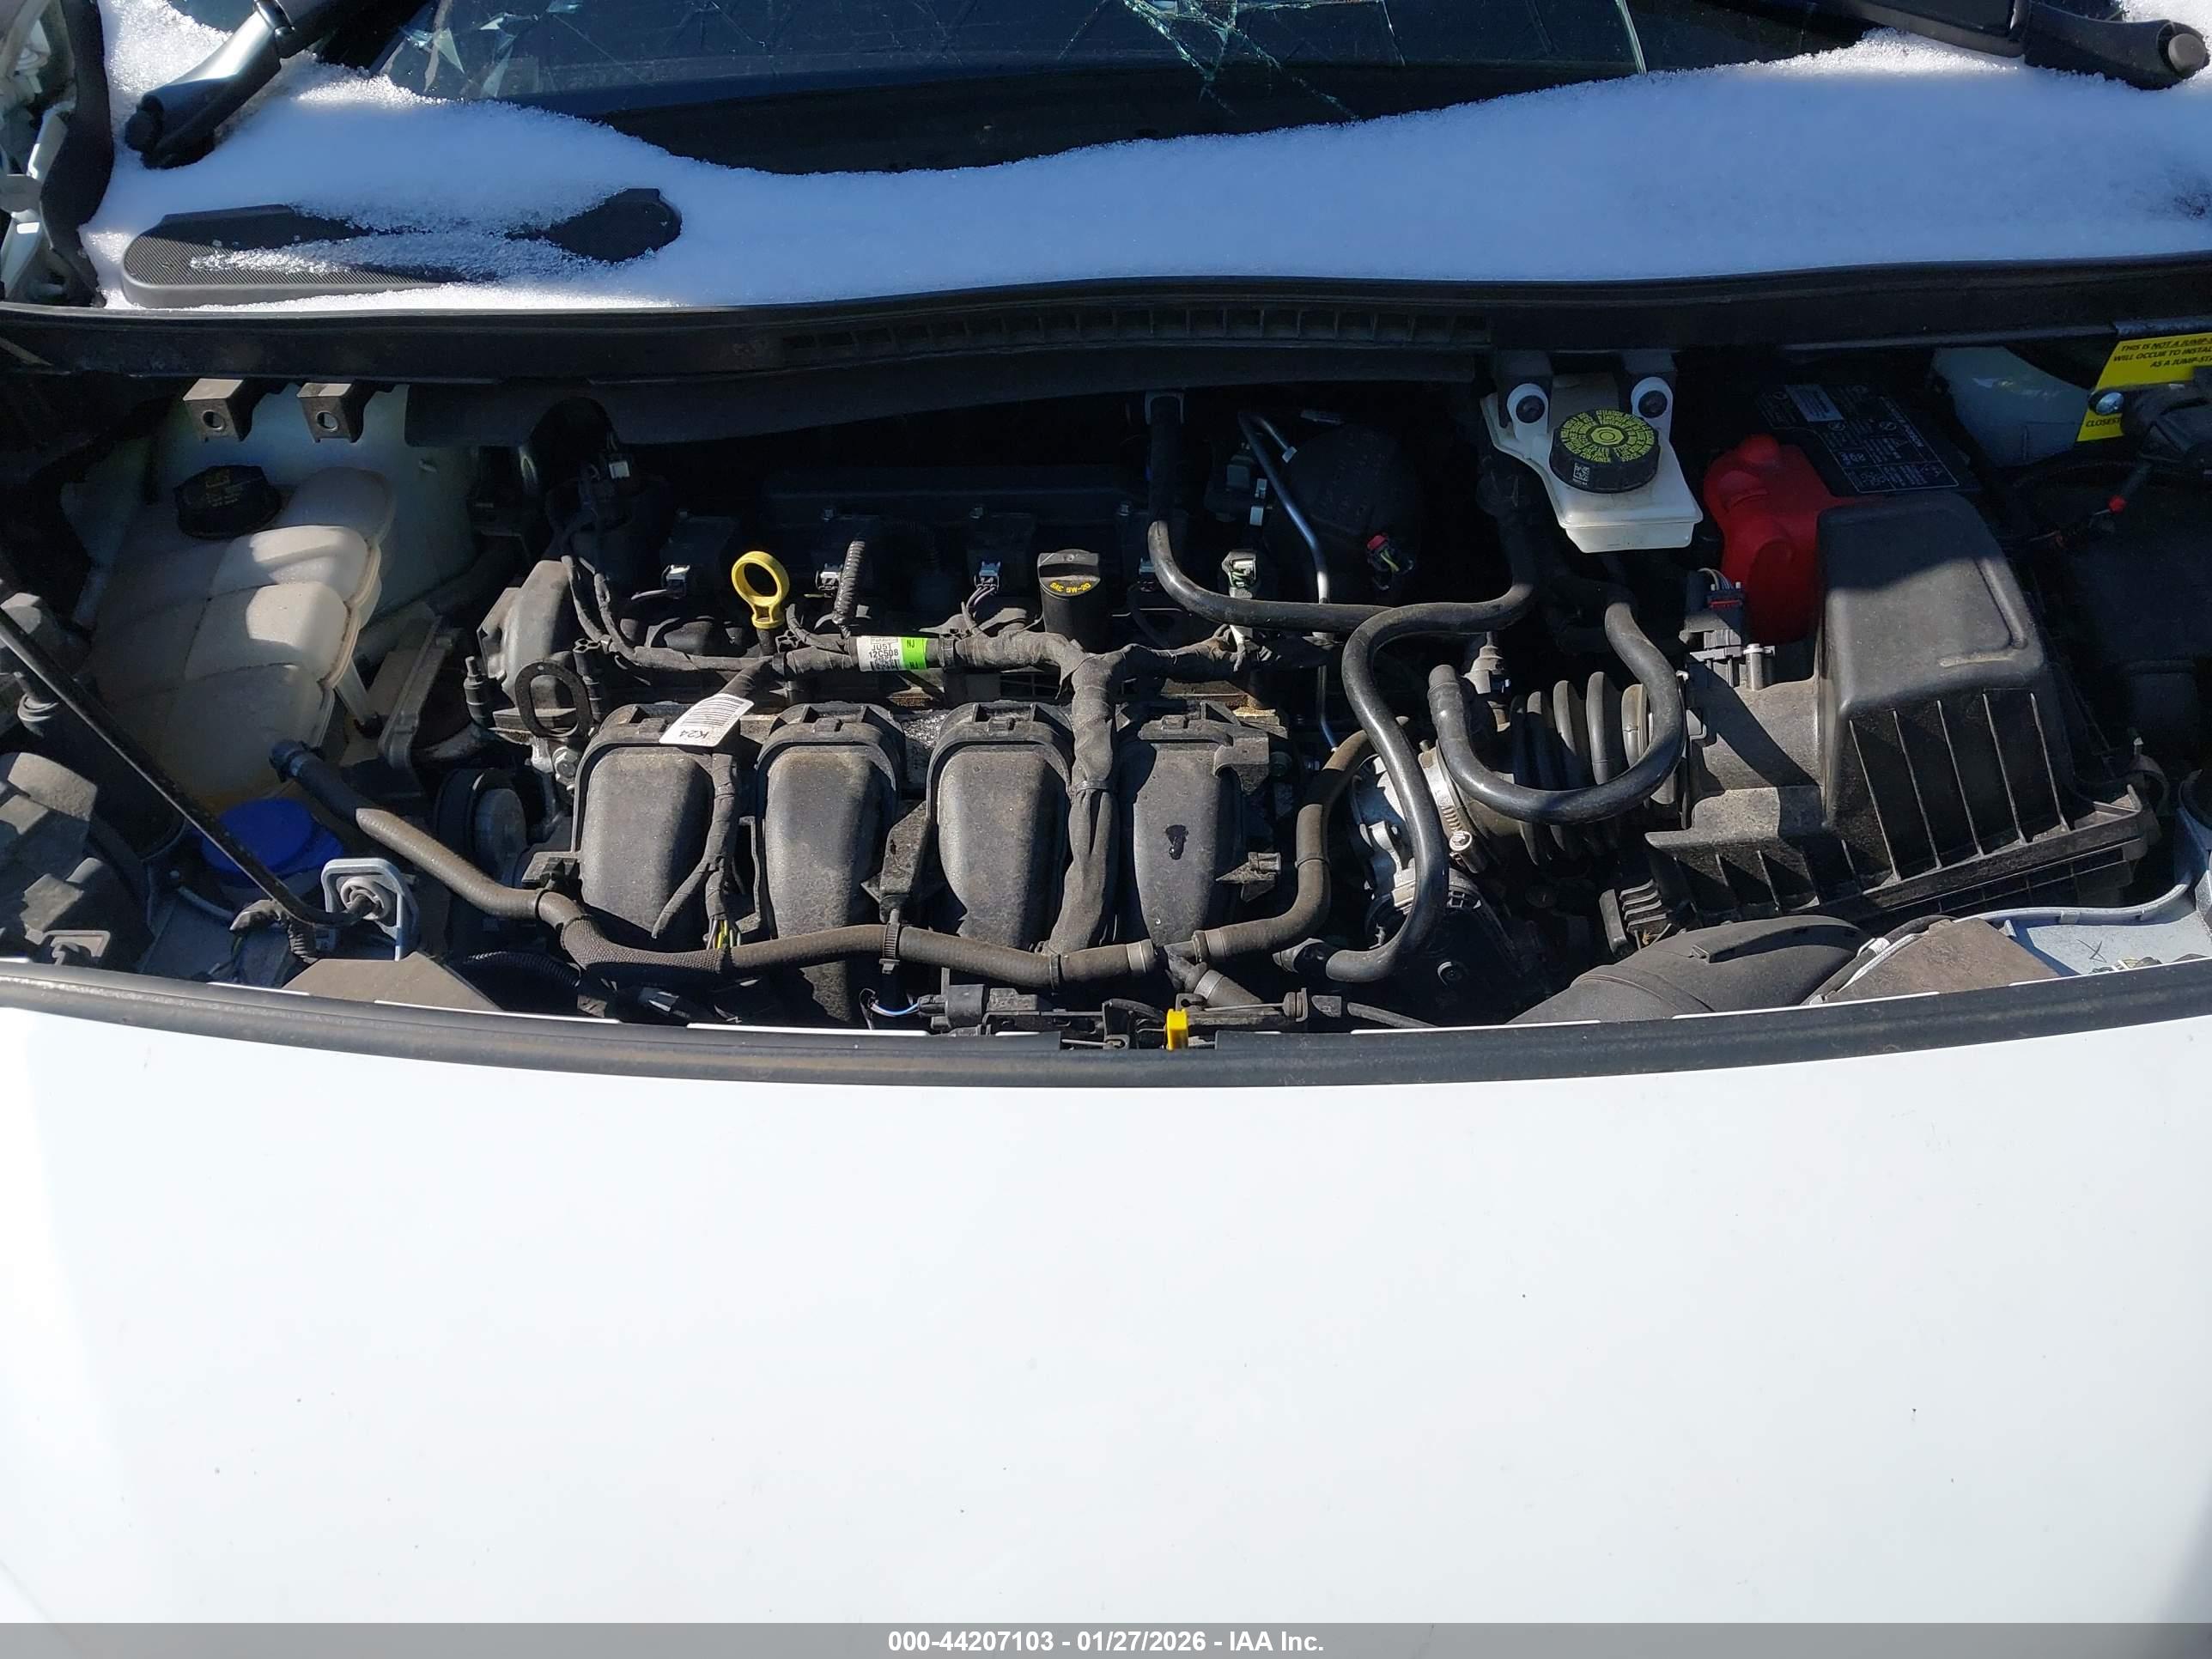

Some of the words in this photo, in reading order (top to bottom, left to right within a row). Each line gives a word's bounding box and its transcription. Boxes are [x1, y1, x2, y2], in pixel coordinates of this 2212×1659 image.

[2151, 340, 2171, 349] NOT
[2136, 350, 2166, 359] OCCUR
[2086, 417, 2121, 427] CLOSEST
[1049, 582, 1065, 592] SAE
[1066, 582, 1091, 593] 5W-20
[906, 639, 915, 648] NJ
[868, 648, 899, 659] 12C508
[679, 729, 709, 739] K24
